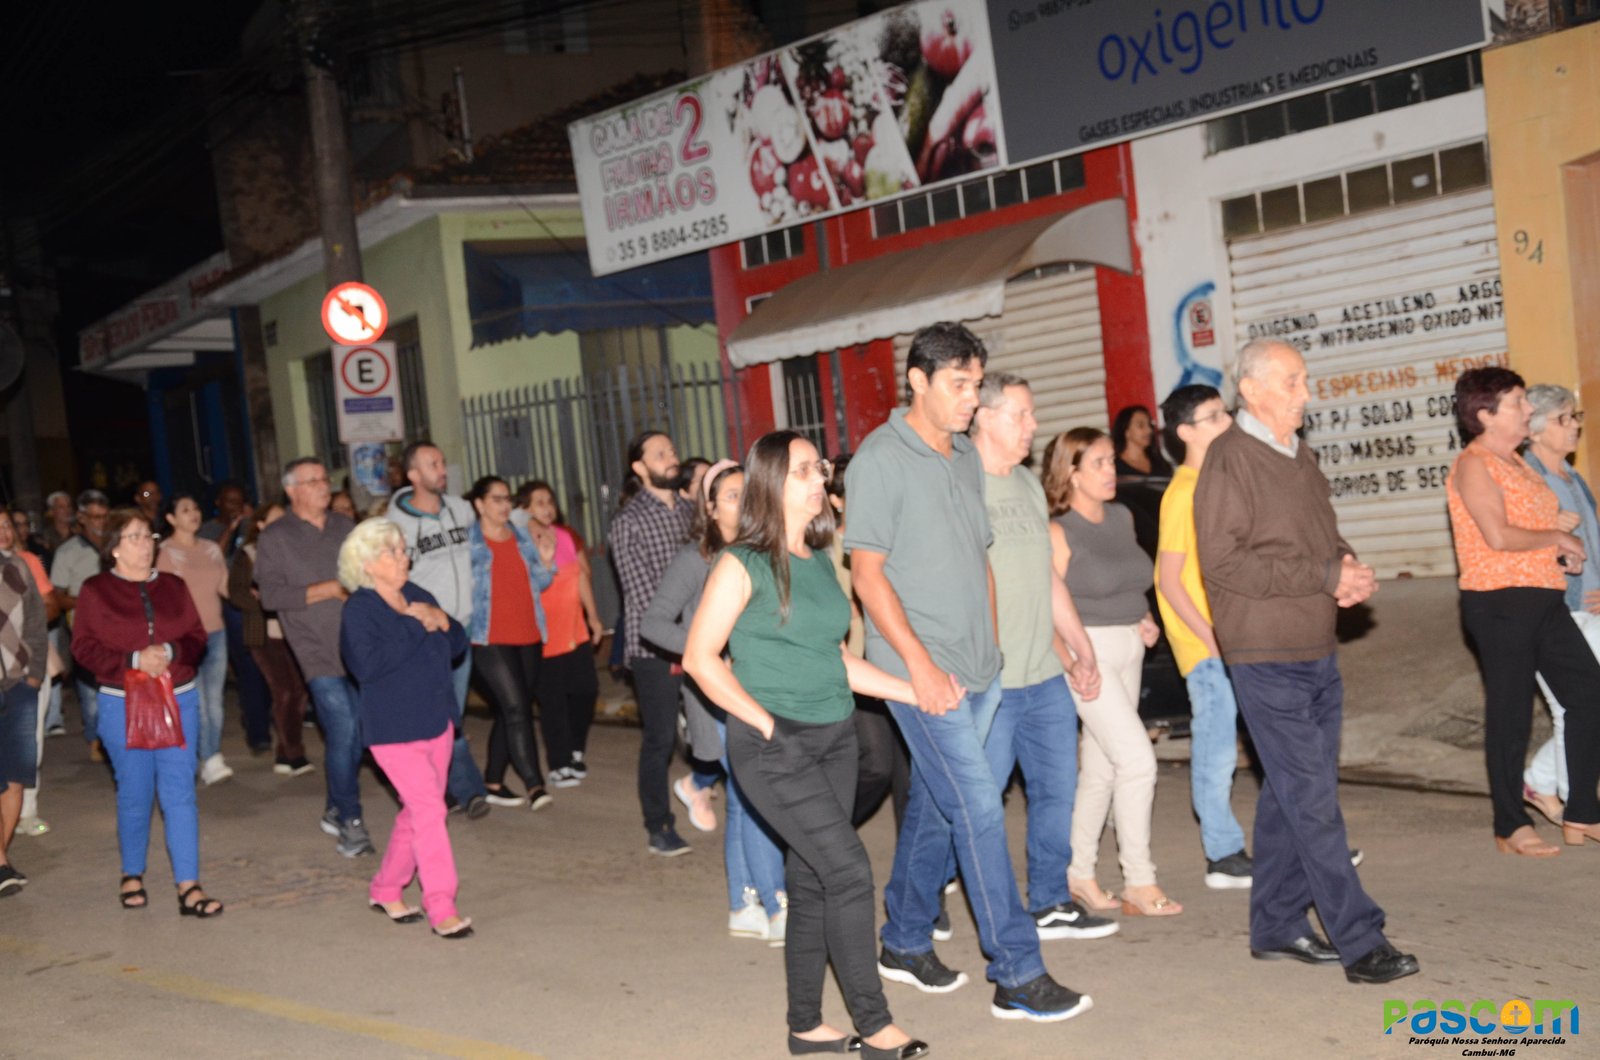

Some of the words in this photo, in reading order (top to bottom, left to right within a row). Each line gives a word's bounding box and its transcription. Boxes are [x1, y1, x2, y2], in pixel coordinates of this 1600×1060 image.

[1078, 117, 1119, 142] GASES
[1276, 72, 1287, 91] E
[1289, 47, 1379, 87] MEDICINAIS
[641, 101, 674, 141] DE
[672, 91, 713, 167] 2
[601, 141, 674, 193] FRUTAS
[604, 166, 717, 232] IRMÃOS
[618, 238, 637, 261] 35
[639, 236, 648, 255] 9
[652, 214, 730, 254] 8804-5285
[1513, 229, 1544, 264] 94
[1320, 316, 1415, 347] NITROGENIO
[1422, 307, 1472, 332] OXIDO
[1342, 292, 1437, 323] ACETILENO
[357, 358, 375, 384] E
[1361, 401, 1414, 428] SOLDA
[1350, 435, 1416, 461] MASSAS
[1386, 470, 1407, 492] DE
